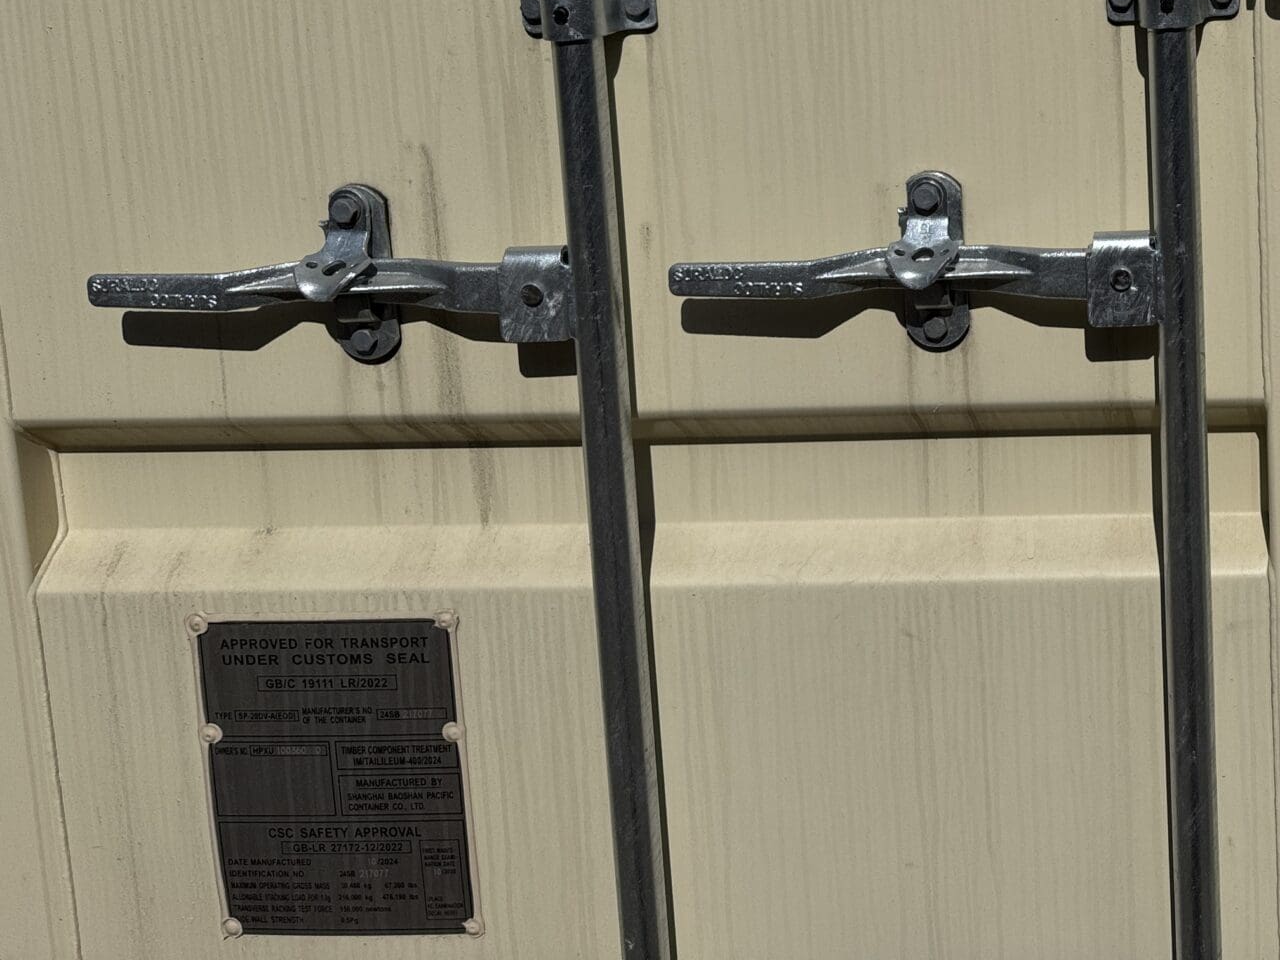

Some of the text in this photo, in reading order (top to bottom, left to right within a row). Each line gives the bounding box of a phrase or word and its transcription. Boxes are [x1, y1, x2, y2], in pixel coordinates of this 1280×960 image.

[220, 637, 429, 651] APPROVED FOR TRANSPORT
[222, 653, 430, 666] UNDER CUSTOMS SEAL
[265, 678, 388, 689] GB/C 19111 LR/2022
[214, 712, 233, 720] TYPE
[315, 716, 328, 724] THE
[331, 716, 366, 724] CONTAINER
[341, 744, 452, 754] TIMBER COMPONENT TREATMENT
[355, 777, 442, 787] MANUFACTURED BY
[348, 791, 454, 801] SHANGHAI BAOSHAN PACIFIC
[349, 803, 389, 811] CONTAINER
[268, 826, 422, 838] CSC SAFETY APPROVAL
[292, 843, 326, 853] GB-LR
[228, 858, 249, 866] DATE
[250, 858, 311, 866] MANUFACTURED
[229, 870, 289, 878] IDENTIFICATION
